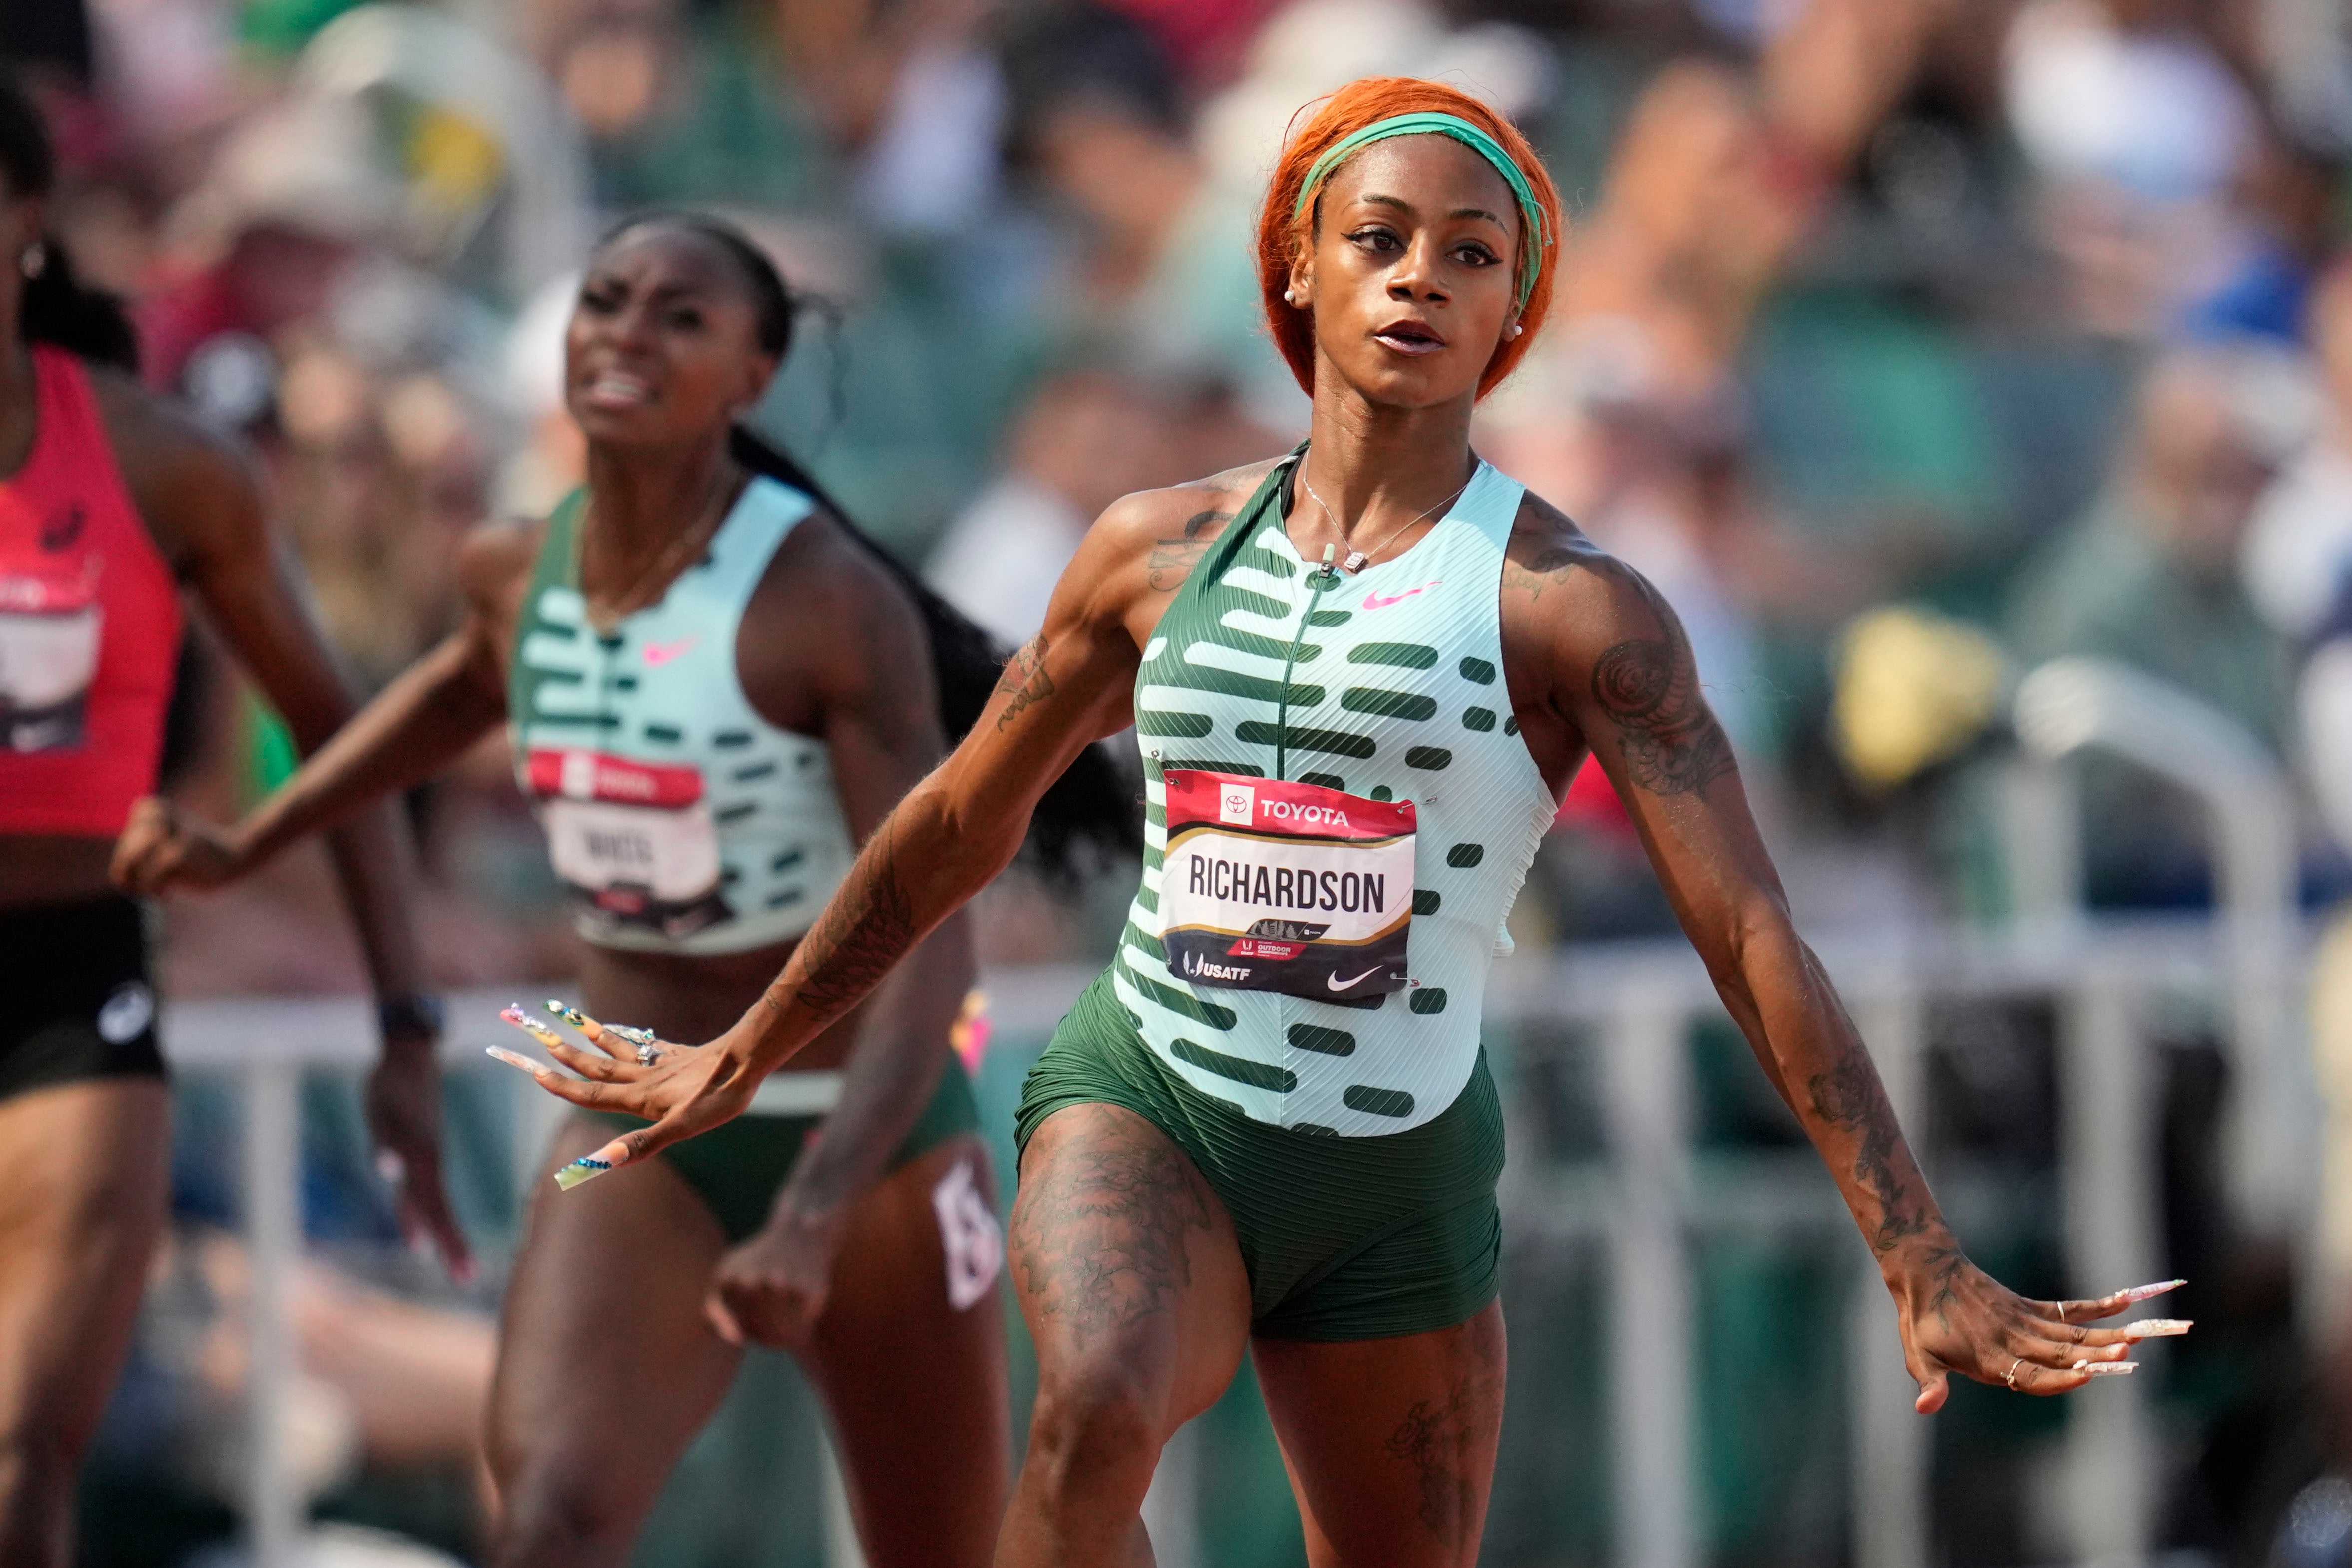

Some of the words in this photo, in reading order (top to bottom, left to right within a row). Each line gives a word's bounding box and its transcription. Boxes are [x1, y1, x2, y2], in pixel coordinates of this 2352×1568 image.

[1261, 799, 1349, 827] TOYOTA
[1190, 854, 1384, 913] RICHARDSON
[1258, 944, 1291, 953] OUTDOOR
[1203, 963, 1251, 981] USATF
